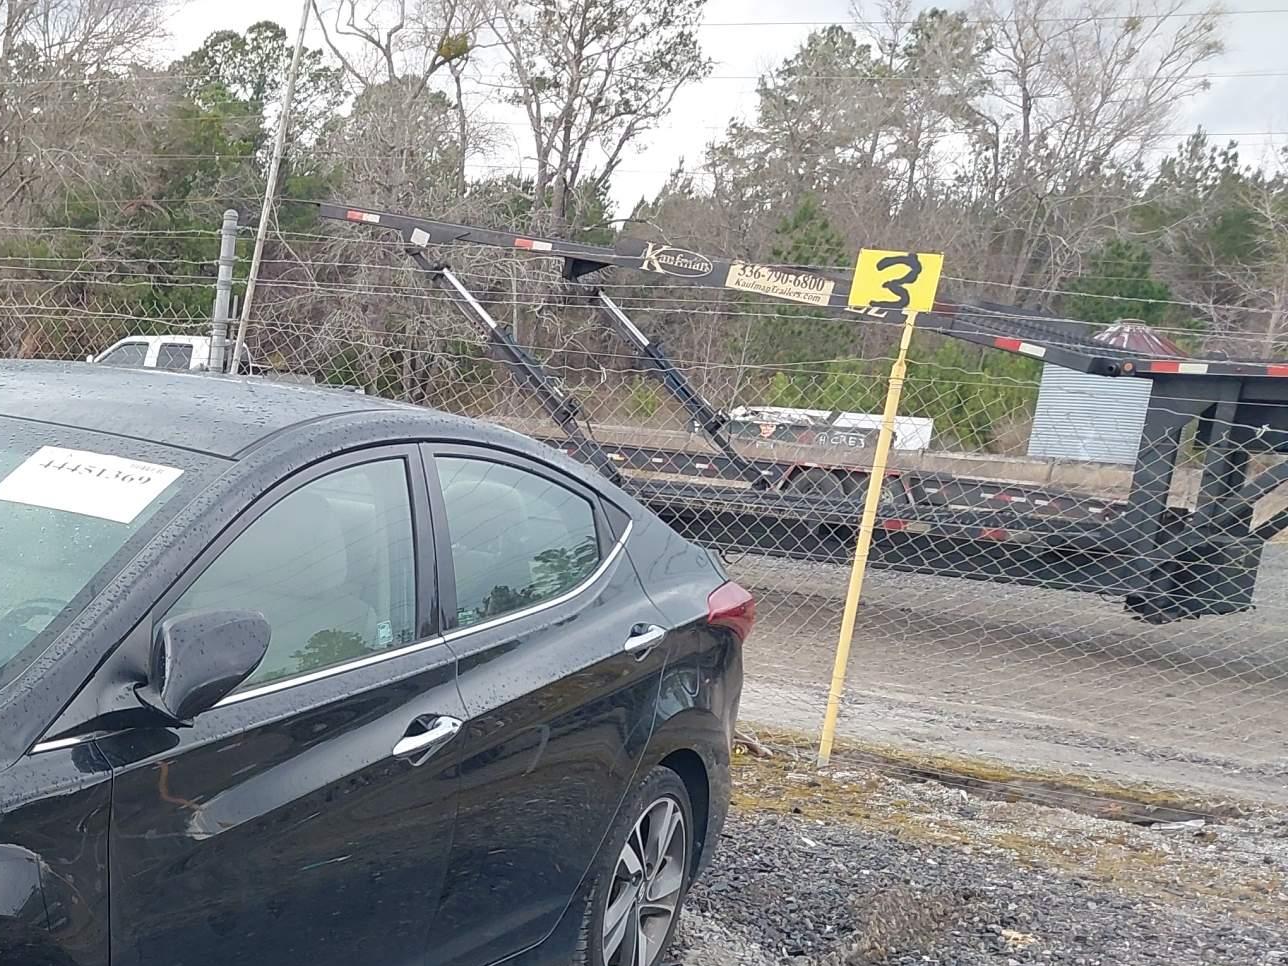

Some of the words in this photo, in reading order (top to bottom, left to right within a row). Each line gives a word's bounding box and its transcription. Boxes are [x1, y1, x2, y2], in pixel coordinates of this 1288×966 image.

[737, 264, 826, 292] 336-790-6800
[869, 253, 922, 309] 3
[40, 459, 152, 485] 44451369
